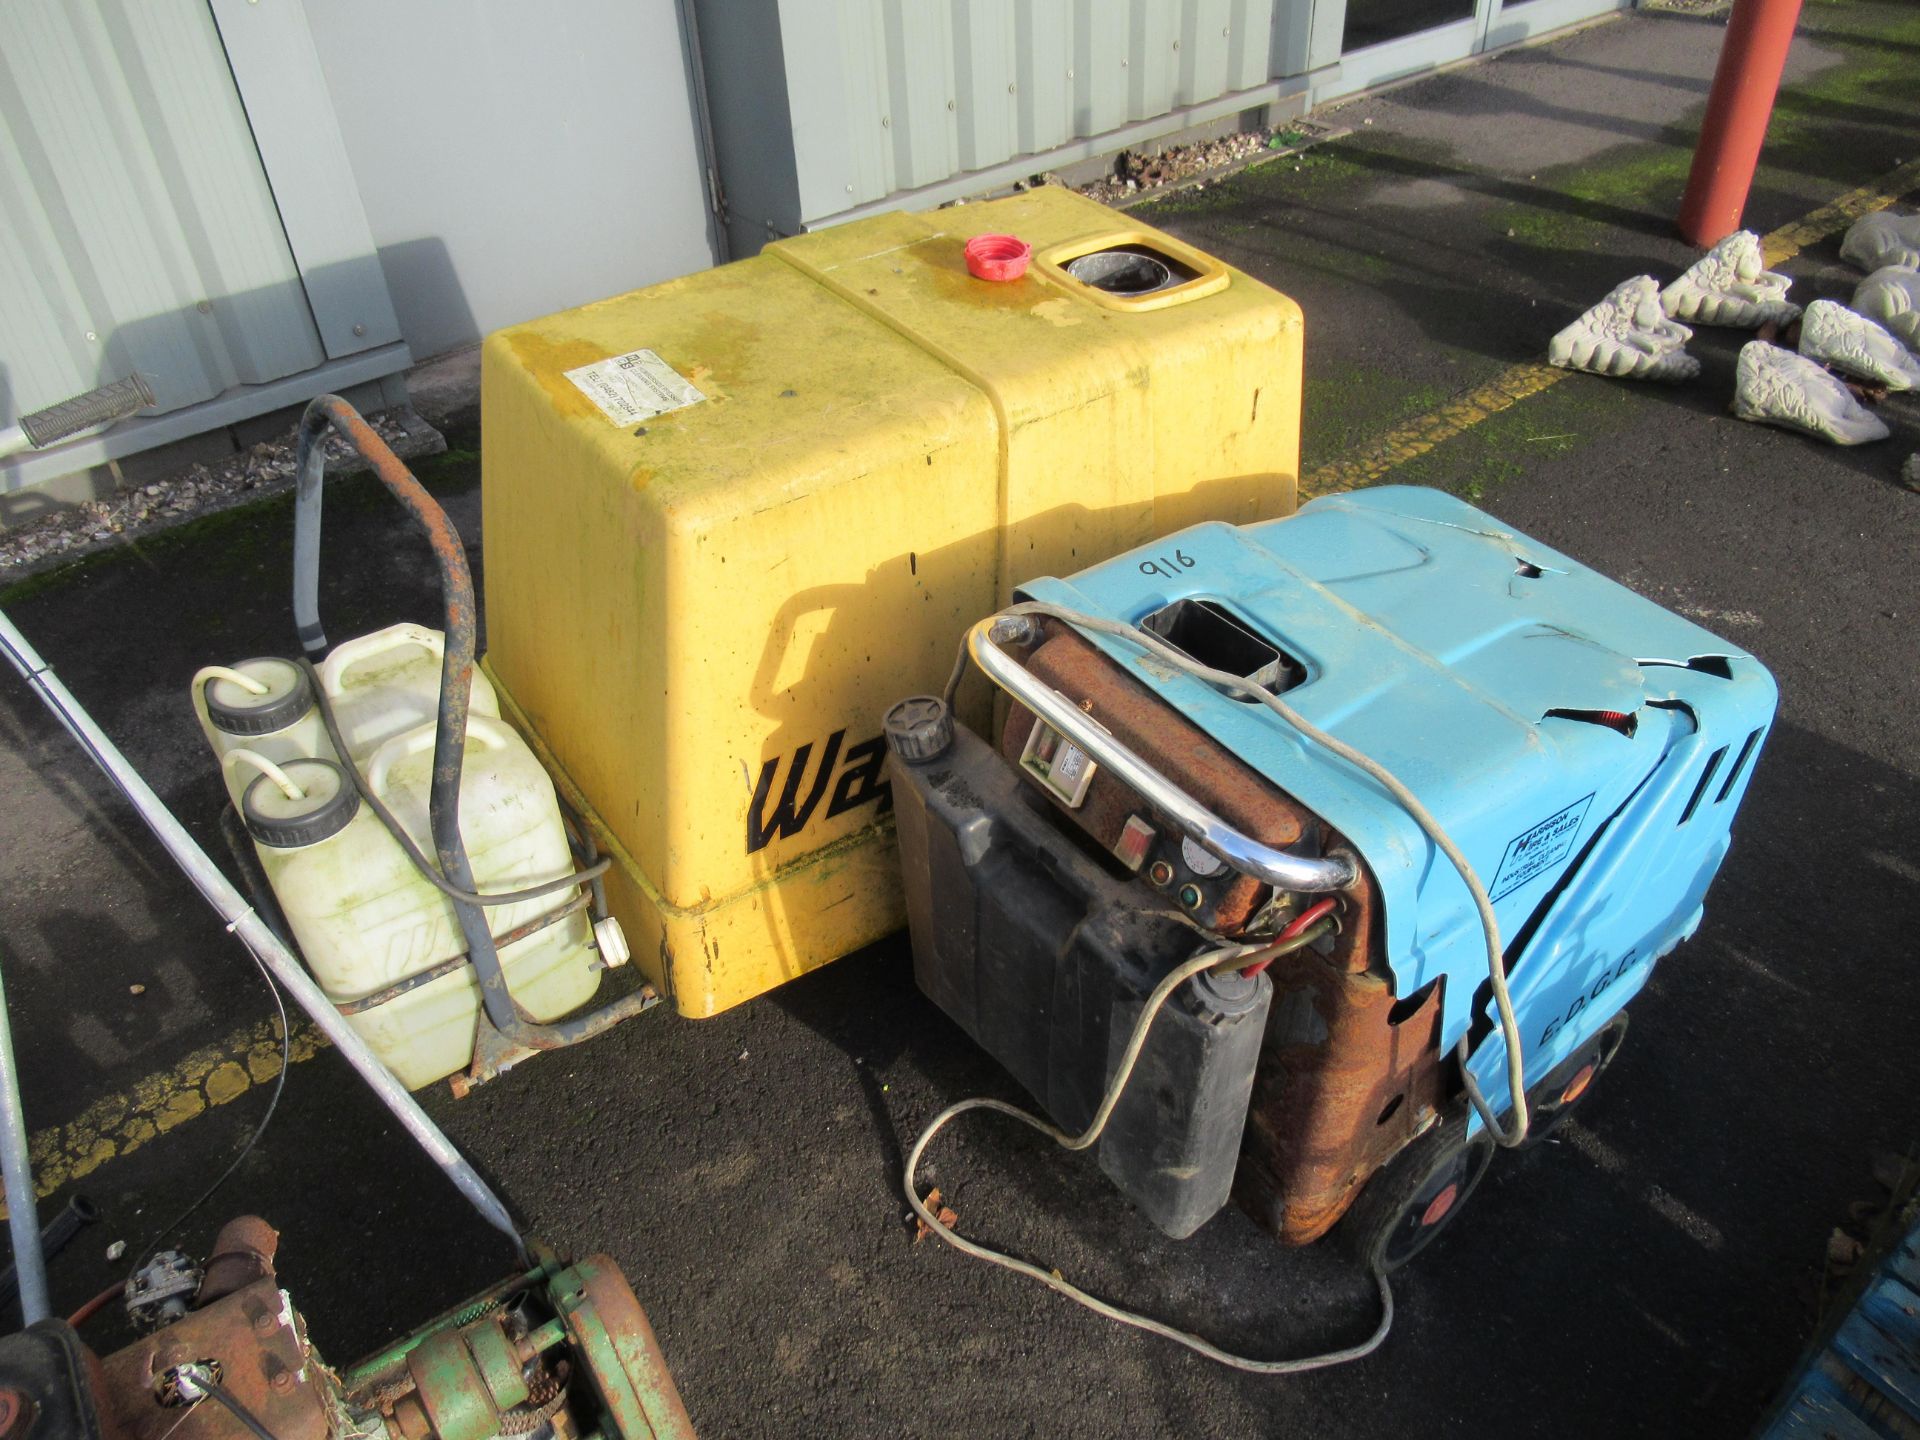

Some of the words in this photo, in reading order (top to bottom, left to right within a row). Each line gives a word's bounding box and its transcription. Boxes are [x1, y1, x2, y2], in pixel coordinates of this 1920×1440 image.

[1139, 549, 1195, 579] 916
[1513, 811, 1569, 856] HARRISON
[1551, 815, 1580, 837] SALES
